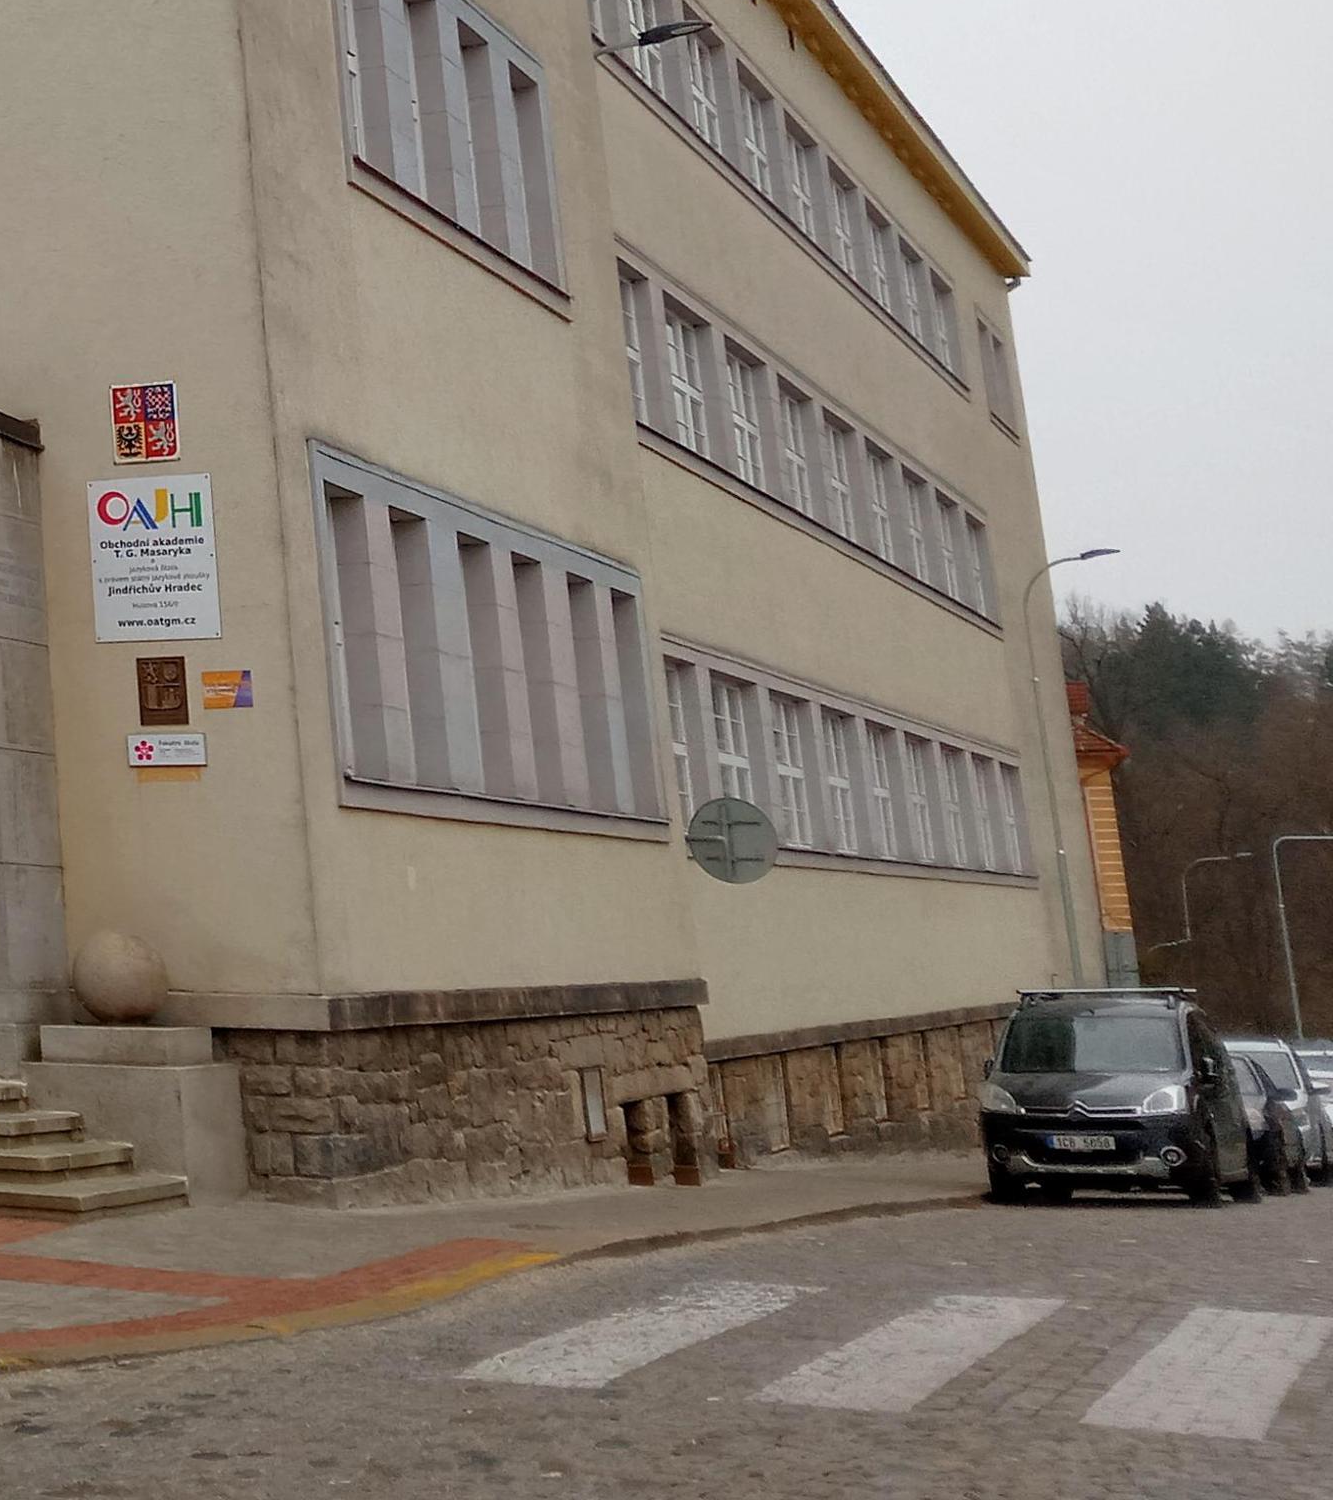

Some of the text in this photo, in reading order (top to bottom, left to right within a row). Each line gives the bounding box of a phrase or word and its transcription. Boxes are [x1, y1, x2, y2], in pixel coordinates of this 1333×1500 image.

[97, 488, 203, 531] OAJH
[99, 536, 205, 550] Obchodní akademie
[126, 549, 137, 558] G.
[140, 546, 192, 558] Masaryka
[108, 583, 203, 597] Jindřichův Hradec
[117, 617, 196, 627] www.oatgm.cz
